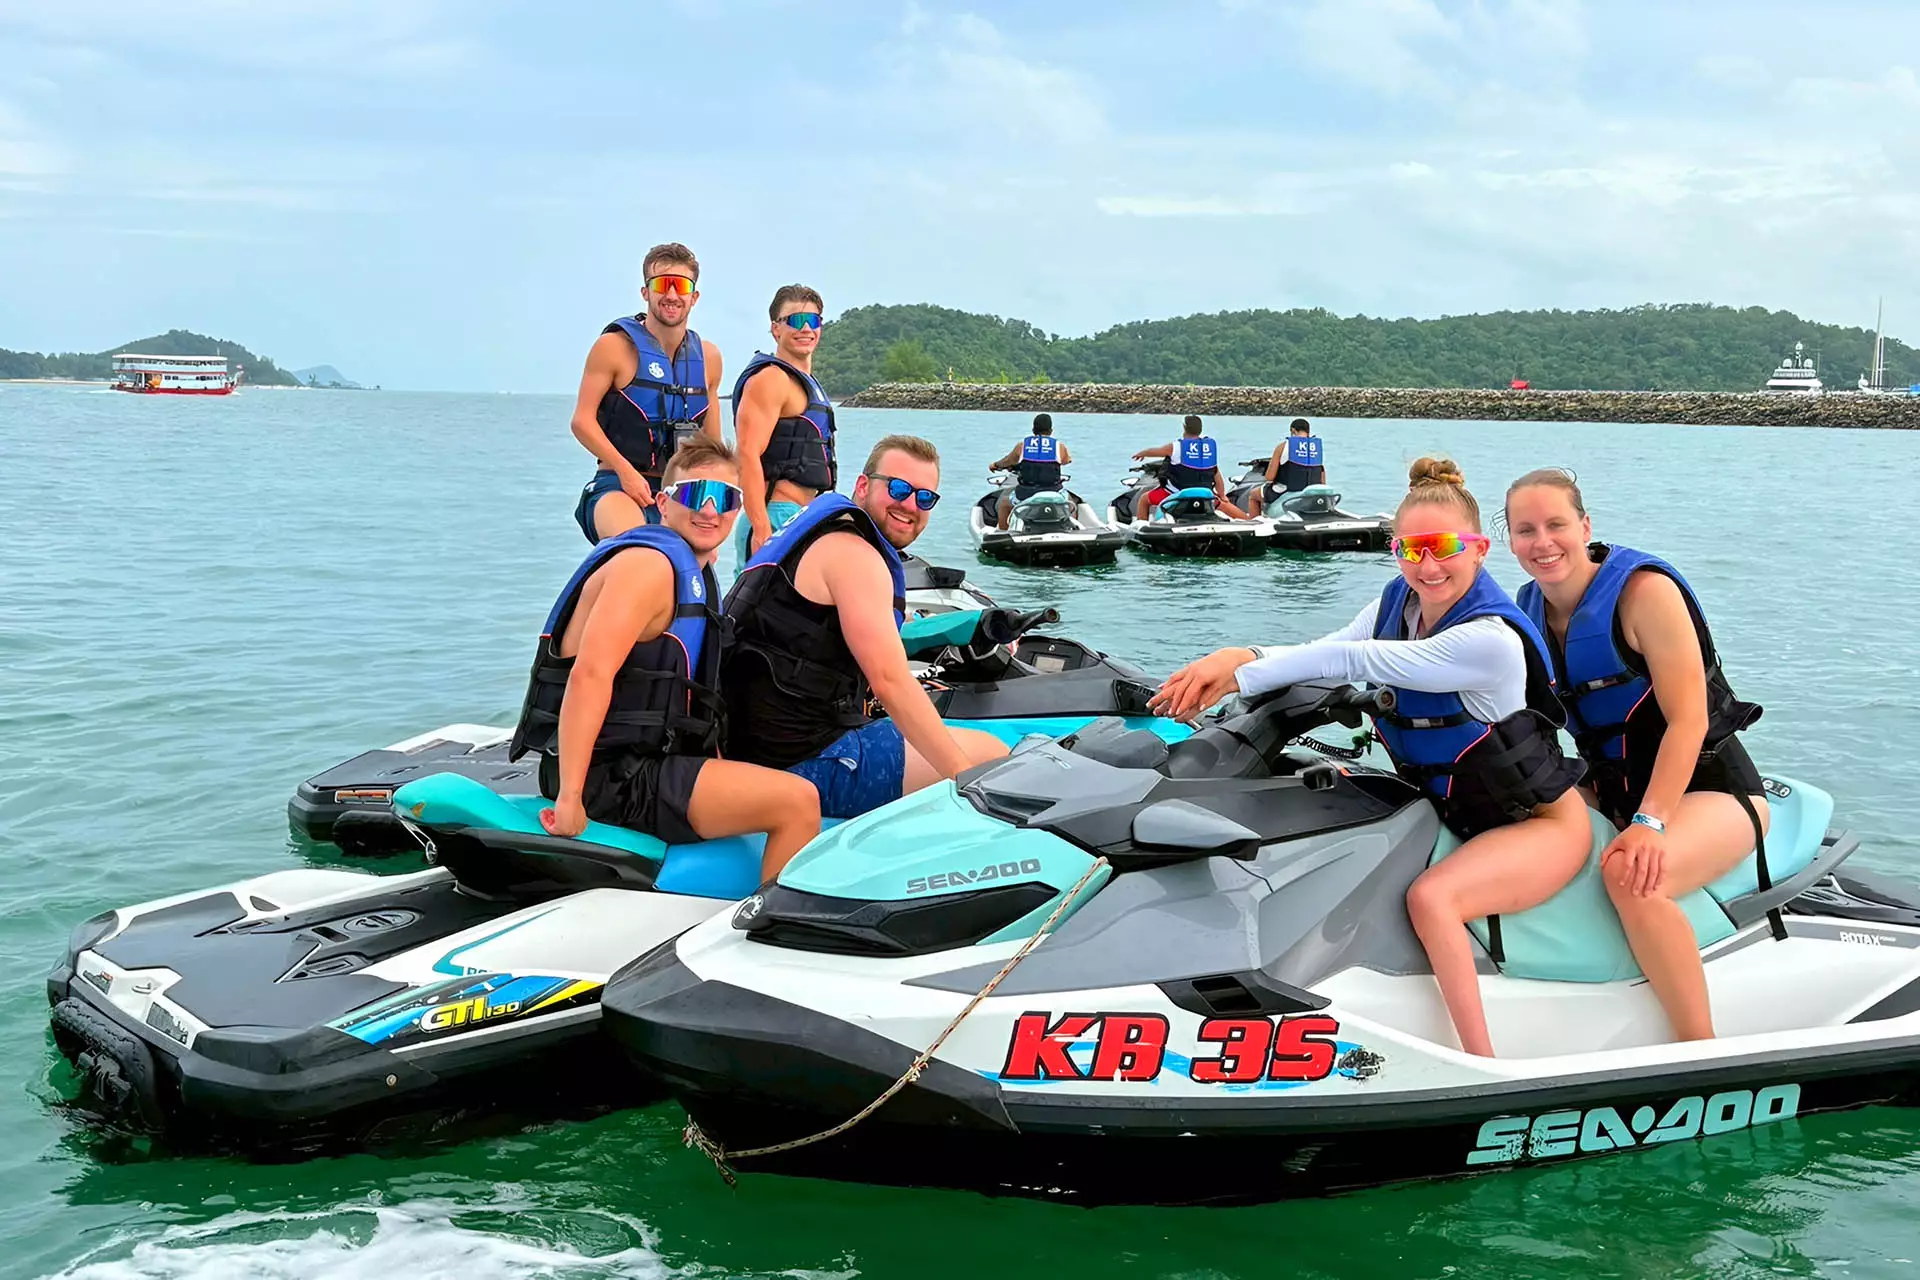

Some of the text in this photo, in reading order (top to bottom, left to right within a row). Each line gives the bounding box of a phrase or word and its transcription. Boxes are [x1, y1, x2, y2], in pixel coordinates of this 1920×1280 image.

[1840, 931, 1881, 946] ROTAX
[419, 996, 487, 1033] GTI
[1001, 1011, 1340, 1083] KB 35
